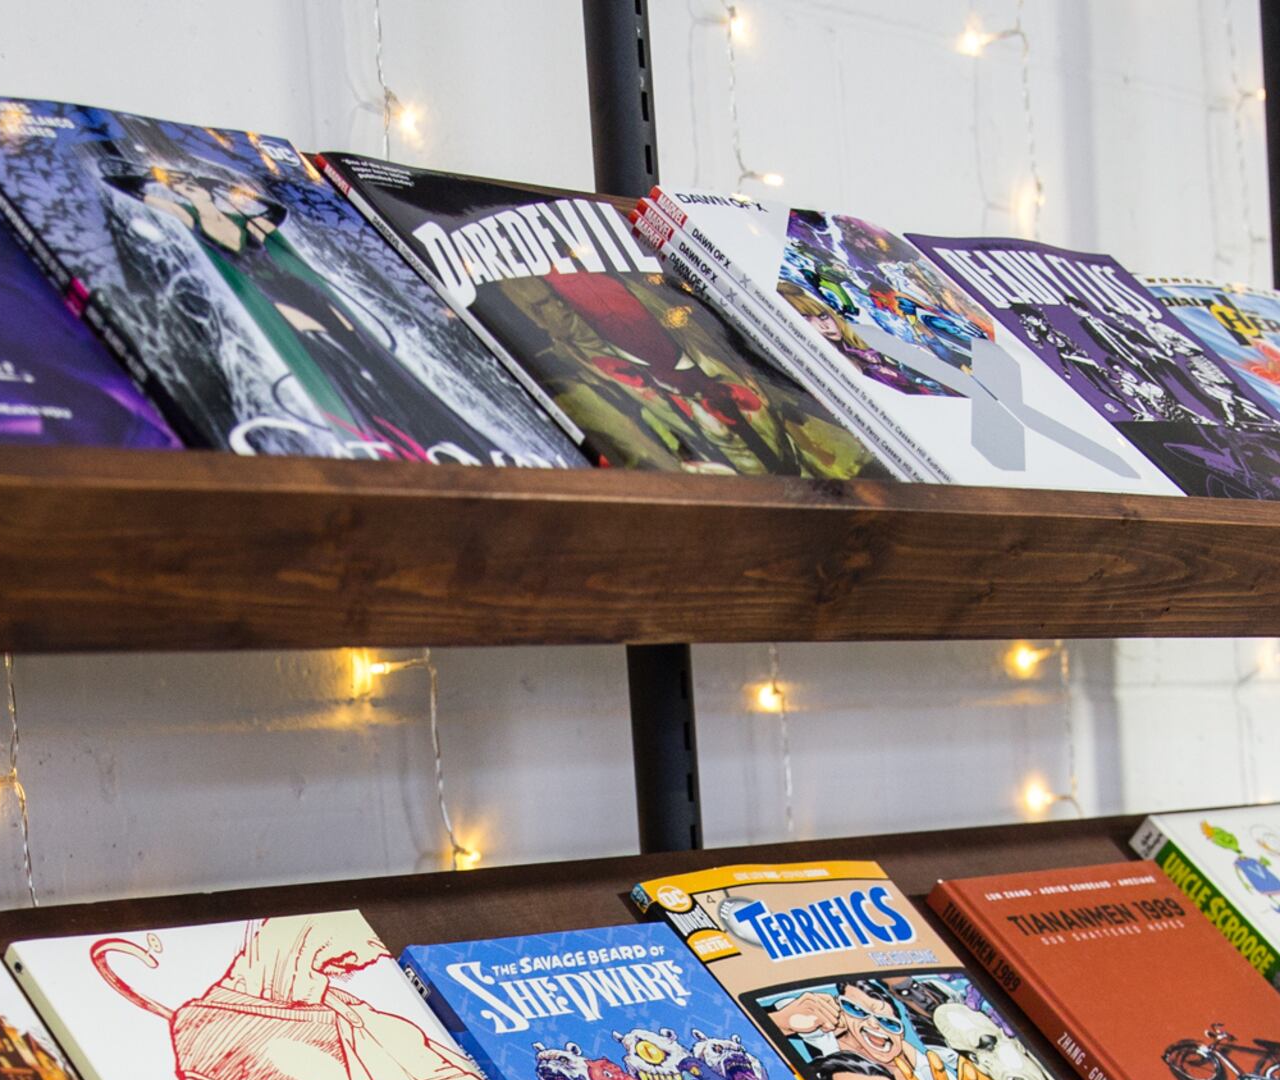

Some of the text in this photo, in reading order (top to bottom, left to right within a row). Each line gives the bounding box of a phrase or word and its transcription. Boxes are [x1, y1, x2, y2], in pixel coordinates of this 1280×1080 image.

[21, 113, 76, 130] BLANCO
[325, 165, 351, 197] MARVEL
[644, 207, 675, 240] MARVEL
[658, 193, 688, 227] MARVEL
[634, 218, 666, 250] MARVEL
[692, 228, 714, 254] DAWN
[412, 199, 663, 308] DAREDEVIL
[678, 241, 701, 268] DAWN
[933, 247, 1162, 321] DEADLY CLASS
[1003, 889, 1033, 900] ZHANG
[1038, 884, 1070, 896] ADRIEN
[1069, 880, 1112, 892] GOMBEAUD
[1163, 851, 1204, 907] UNCLE
[662, 890, 687, 905] DC
[733, 886, 917, 961] TERRIFICS
[1006, 896, 1187, 937] TIANANMEN 1989
[1040, 919, 1186, 946] OUR SHATTERED HOPES
[491, 944, 665, 977] THE SAVAGE BEARD OF
[941, 902, 1020, 992] TIANANMEN 1989
[1056, 1031, 1084, 1064] ZHANG
